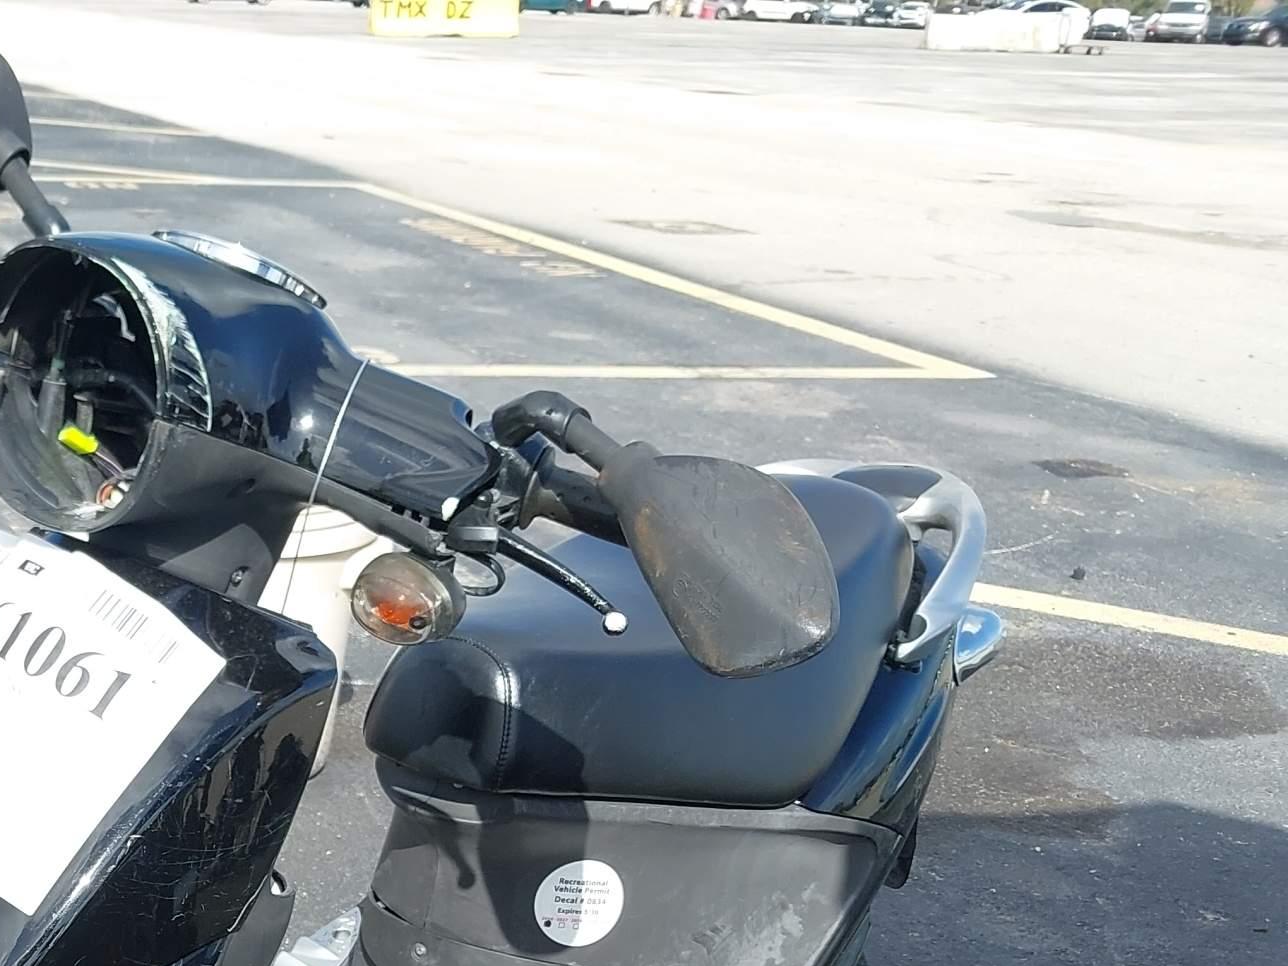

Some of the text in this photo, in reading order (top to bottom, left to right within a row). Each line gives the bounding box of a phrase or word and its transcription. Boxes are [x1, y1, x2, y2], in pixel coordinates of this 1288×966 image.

[381, 1, 474, 19] TMX DZ
[559, 878, 608, 886] Recreational
[554, 885, 609, 895] Vehicle Permit
[554, 896, 579, 905] Decal
